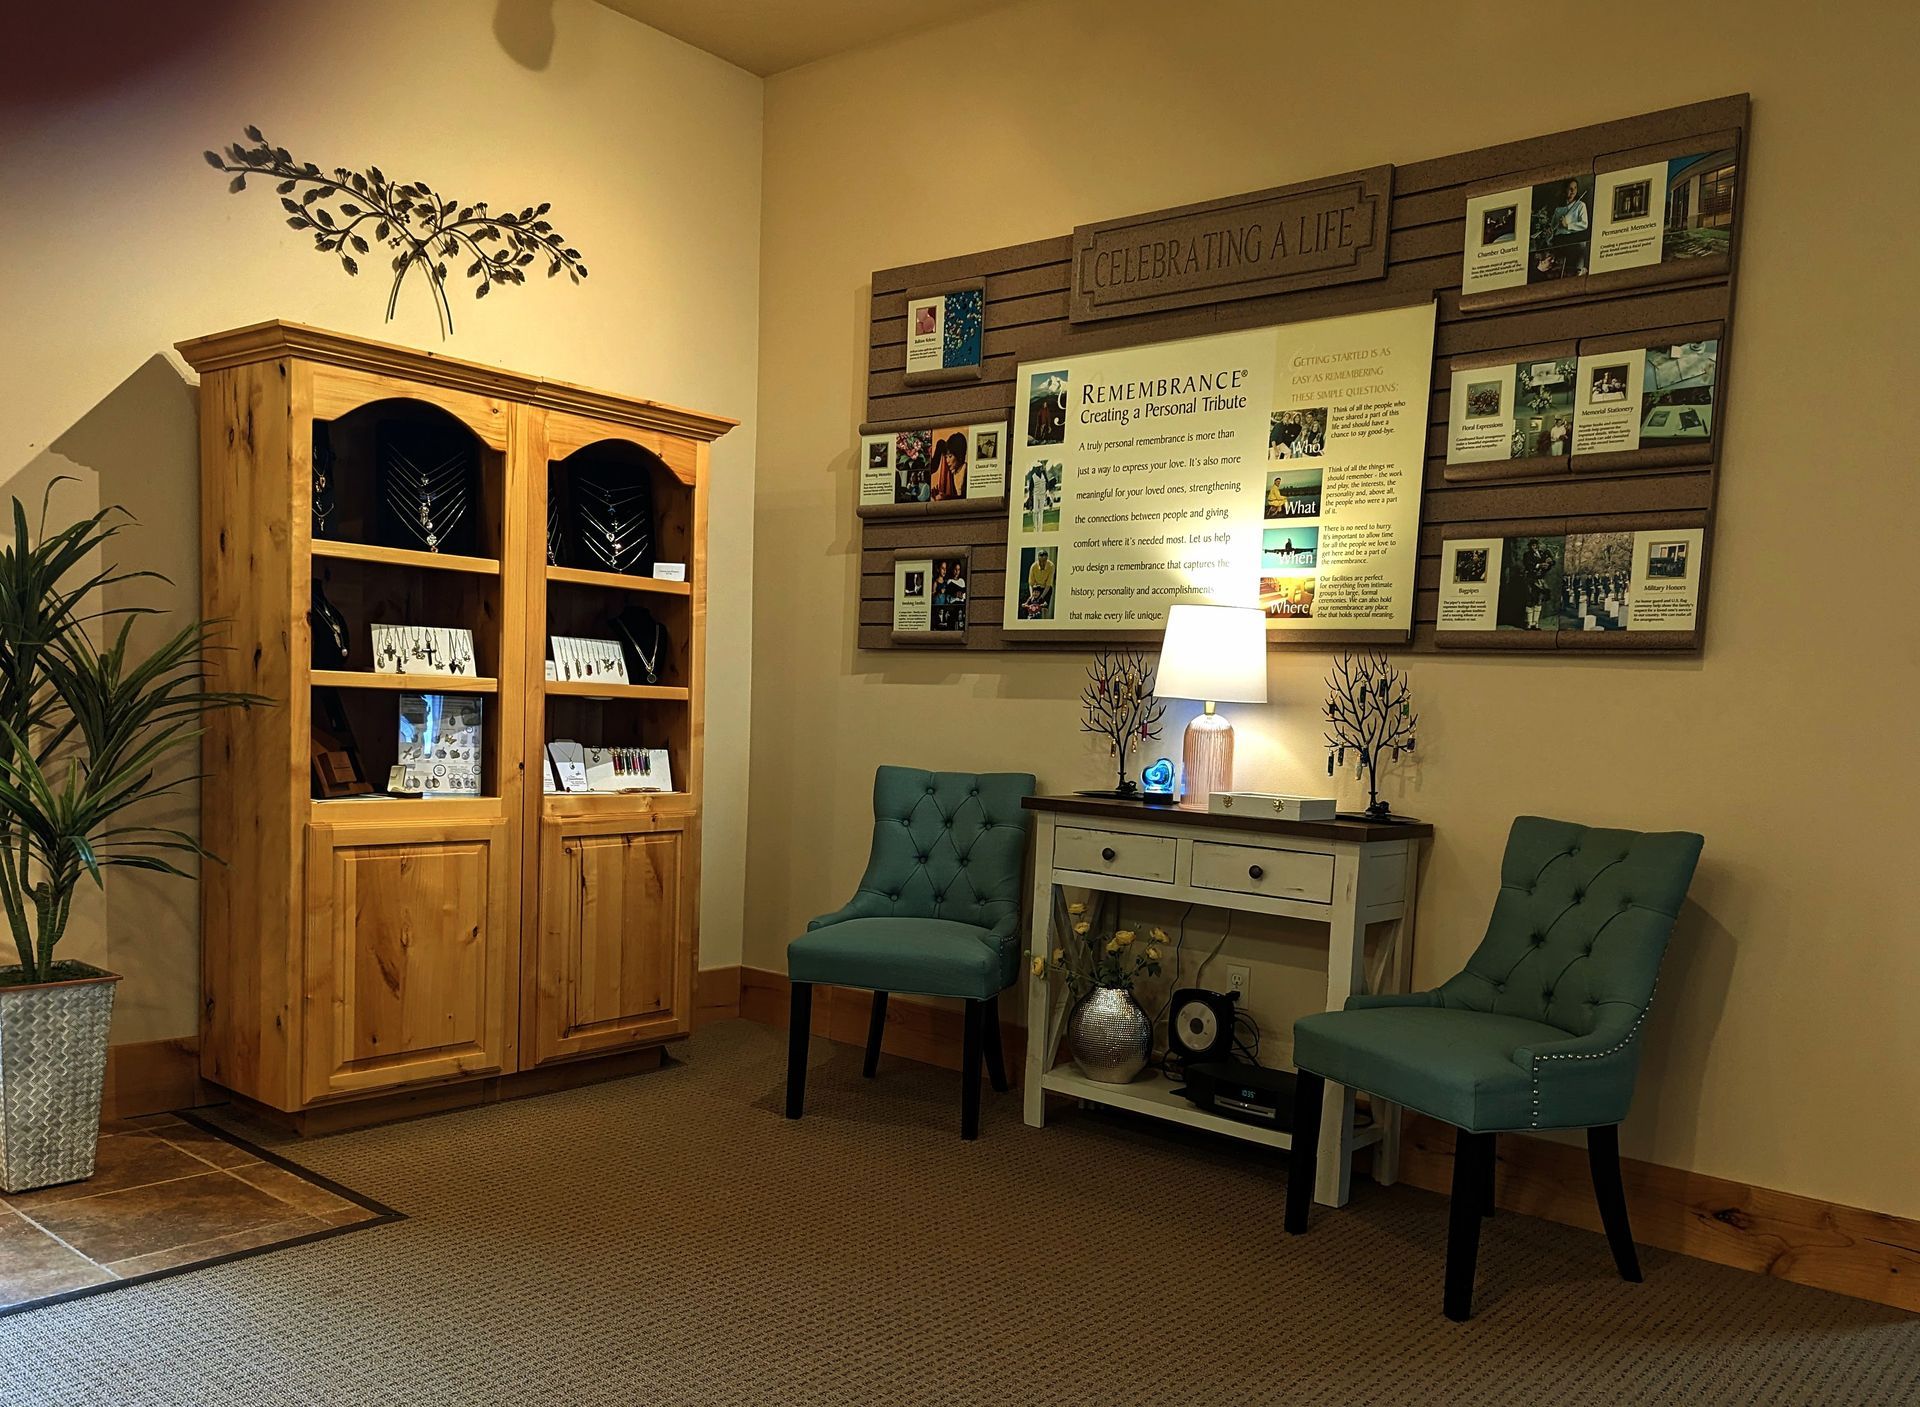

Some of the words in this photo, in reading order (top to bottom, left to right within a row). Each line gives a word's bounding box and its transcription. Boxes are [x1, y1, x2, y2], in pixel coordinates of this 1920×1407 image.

[1602, 227, 1629, 237] Permanent
[1630, 222, 1657, 232] Memories
[1094, 224, 1261, 288] CELEBRATING
[1271, 221, 1288, 260] A
[1299, 207, 1355, 255] LIFE
[1478, 250, 1498, 258] Chamber
[1293, 355, 1330, 366] GETTING
[1331, 351, 1369, 362] STARTED
[1371, 349, 1378, 358] IS
[1379, 348, 1391, 356] AS
[1292, 376, 1311, 384] EASY
[1312, 373, 1323, 382] AS
[1325, 366, 1384, 380] REMEMBERING
[1292, 392, 1315, 402] THESE
[1317, 389, 1345, 400] SIMPLE
[1081, 408, 1129, 425] Creating
[1133, 408, 1140, 419] a
[1145, 398, 1197, 417] Personal
[1202, 395, 1247, 411] Tribute
[1373, 402, 1393, 411] people
[1582, 408, 1606, 416] Memorial
[1369, 412, 1381, 420] part
[1352, 420, 1371, 428] should
[1078, 443, 1085, 451] A
[1087, 441, 1103, 451] truly
[1104, 438, 1134, 451] personal
[1136, 435, 1185, 446] remembrance
[1187, 433, 1193, 441] is
[1218, 429, 1235, 438] than
[1292, 441, 1321, 454] Who
[1077, 467, 1090, 478] just
[1097, 467, 1111, 476] way
[1122, 464, 1148, 474] express
[1149, 462, 1167, 473] your
[1169, 459, 1186, 468] love.
[1189, 458, 1201, 466] It's
[1203, 456, 1219, 465] also
[1076, 489, 1113, 501] meaningful
[1115, 488, 1125, 497] for
[1126, 489, 1144, 499] your
[1145, 485, 1165, 495] loved
[1189, 481, 1241, 494] strengthening
[1326, 490, 1355, 499] personality
[1285, 500, 1316, 514] What
[1075, 515, 1086, 523] the
[1087, 514, 1129, 523] connections
[1131, 512, 1161, 520] between
[1162, 509, 1188, 523] people
[1190, 508, 1204, 517] and
[1205, 508, 1229, 521] giving
[1073, 538, 1100, 548] comfort
[1102, 537, 1123, 546] where
[1125, 537, 1136, 545] it's
[1137, 535, 1164, 545] needed
[1166, 536, 1186, 544] most.
[1189, 534, 1201, 543] Let
[1214, 532, 1231, 545] help
[1280, 551, 1313, 565] When
[1071, 566, 1084, 575] you
[1086, 563, 1109, 574] design
[1117, 561, 1165, 570] remembrance
[1167, 560, 1181, 569] that
[1183, 561, 1215, 571] captures
[1071, 587, 1095, 598] history,
[1097, 586, 1135, 598] personality
[1136, 586, 1150, 594] and
[1271, 601, 1309, 614] Where
[1069, 611, 1082, 619] that
[1084, 611, 1102, 619] make
[1104, 613, 1123, 622] every
[1125, 610, 1135, 619] life
[1137, 611, 1163, 622] unique.
